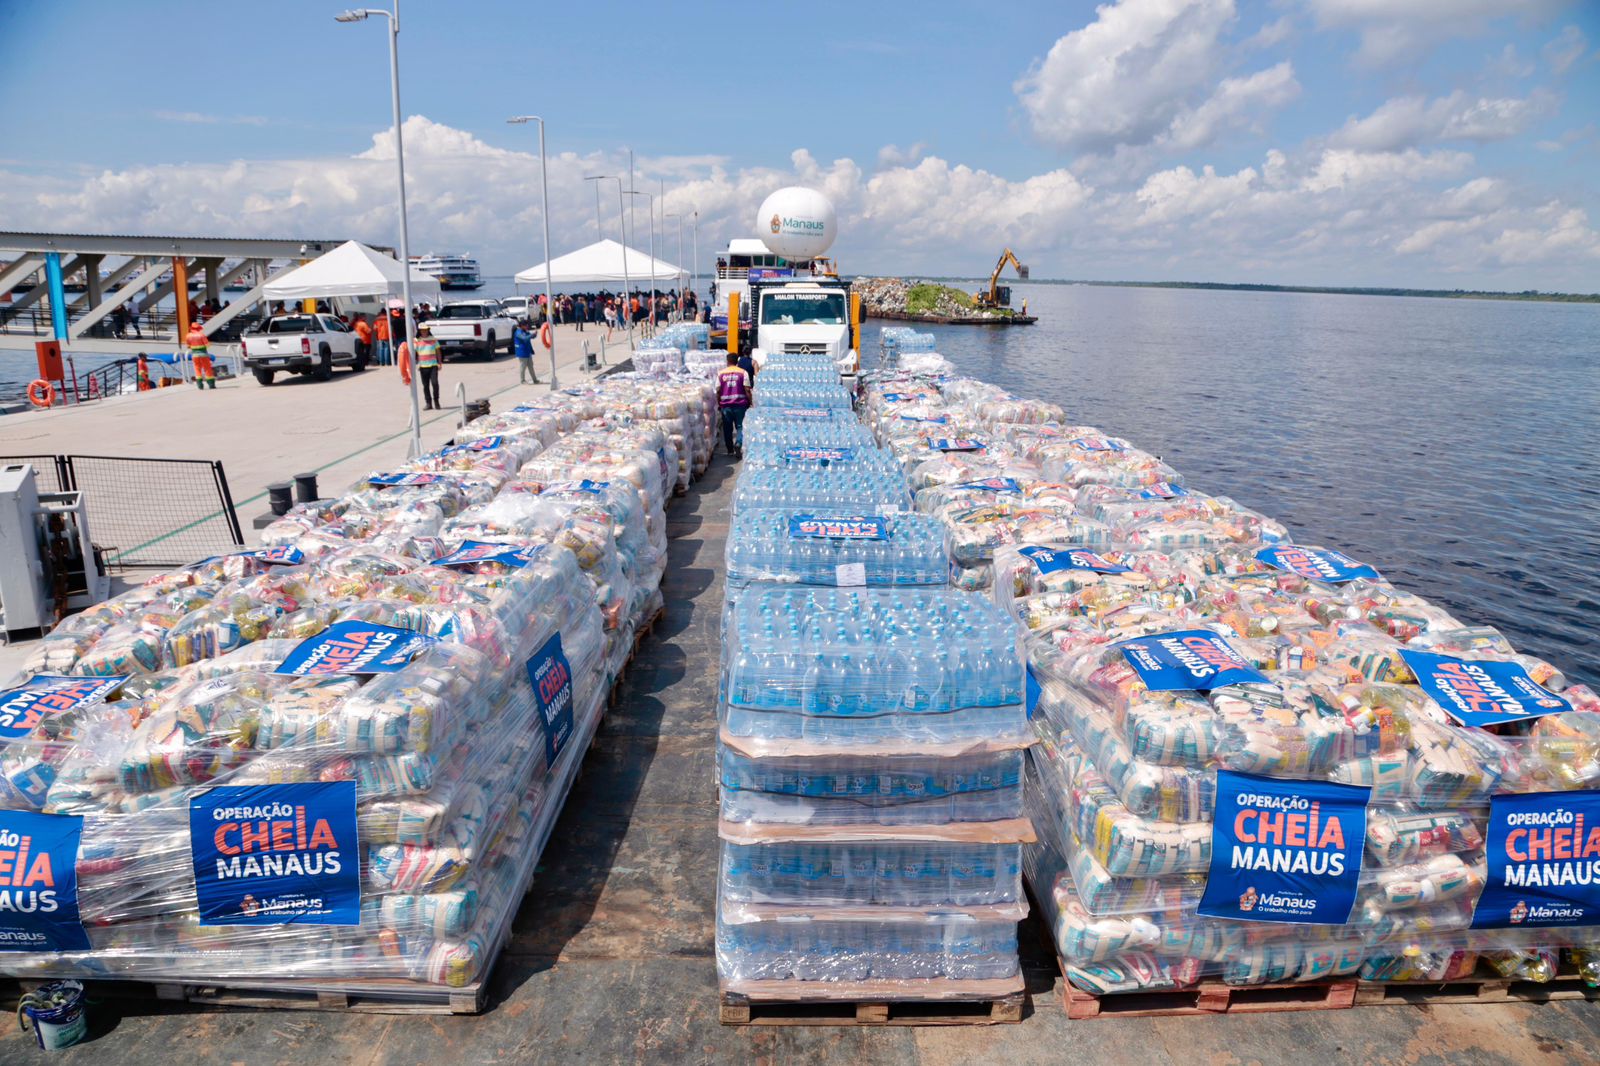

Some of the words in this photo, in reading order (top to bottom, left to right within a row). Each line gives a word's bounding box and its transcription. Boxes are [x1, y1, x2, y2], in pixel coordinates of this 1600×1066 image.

[783, 217, 824, 230] Manaus
[308, 631, 376, 675] CHEIA
[1157, 637, 1215, 678] MANAUS
[539, 656, 569, 705] CHEIA
[1432, 662, 1503, 714] CHEIA
[1461, 663, 1531, 715] MANAUS
[12, 679, 106, 729] CHEIA
[545, 682, 570, 726] MANAUS
[212, 802, 293, 821] OPERAÇÃO
[1236, 793, 1309, 812] OPERAÇÃO
[1507, 808, 1574, 828] OPERAÇÃO
[214, 805, 339, 856] CHEIA
[1234, 801, 1346, 850] CHEIA
[1505, 813, 1600, 862] CHEIA
[0, 836, 55, 887] EIA
[216, 851, 342, 880] MANAUS
[1231, 845, 1346, 877] MANAUS
[0, 890, 59, 913] AUS
[262, 898, 323, 909] Manaus
[1259, 893, 1317, 910] Manaus
[1528, 906, 1584, 918] Manaus
[0, 931, 46, 941] anaus
